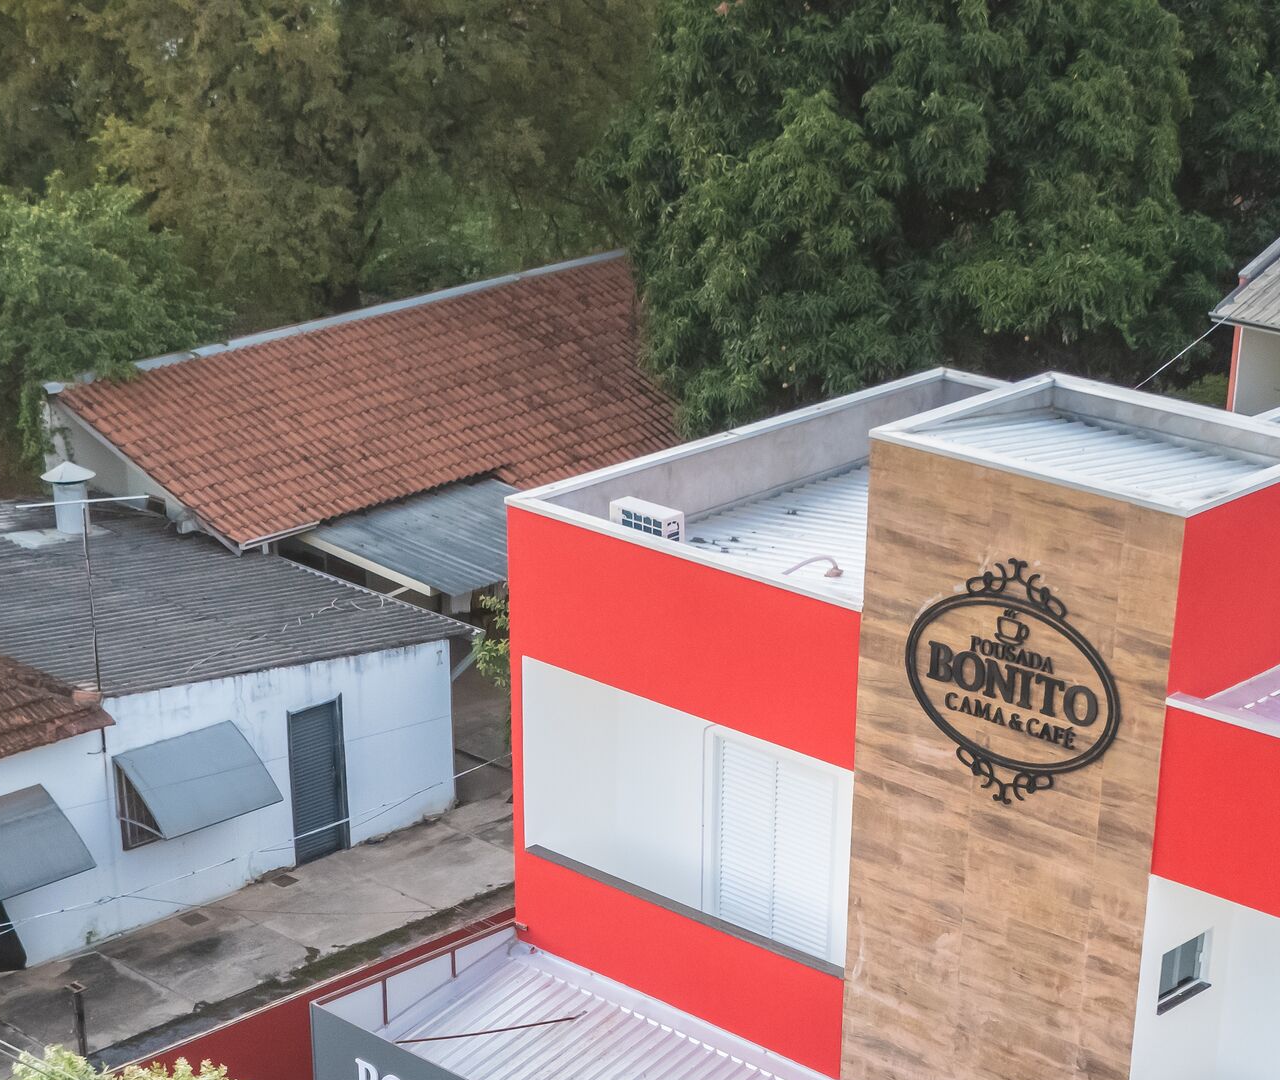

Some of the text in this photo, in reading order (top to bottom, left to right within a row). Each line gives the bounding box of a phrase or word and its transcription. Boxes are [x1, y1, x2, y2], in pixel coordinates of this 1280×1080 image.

[926, 640, 1099, 727] BONITO
[970, 635, 1054, 674] POUSADA
[944, 692, 1076, 750] CAMA & CAFÉ
